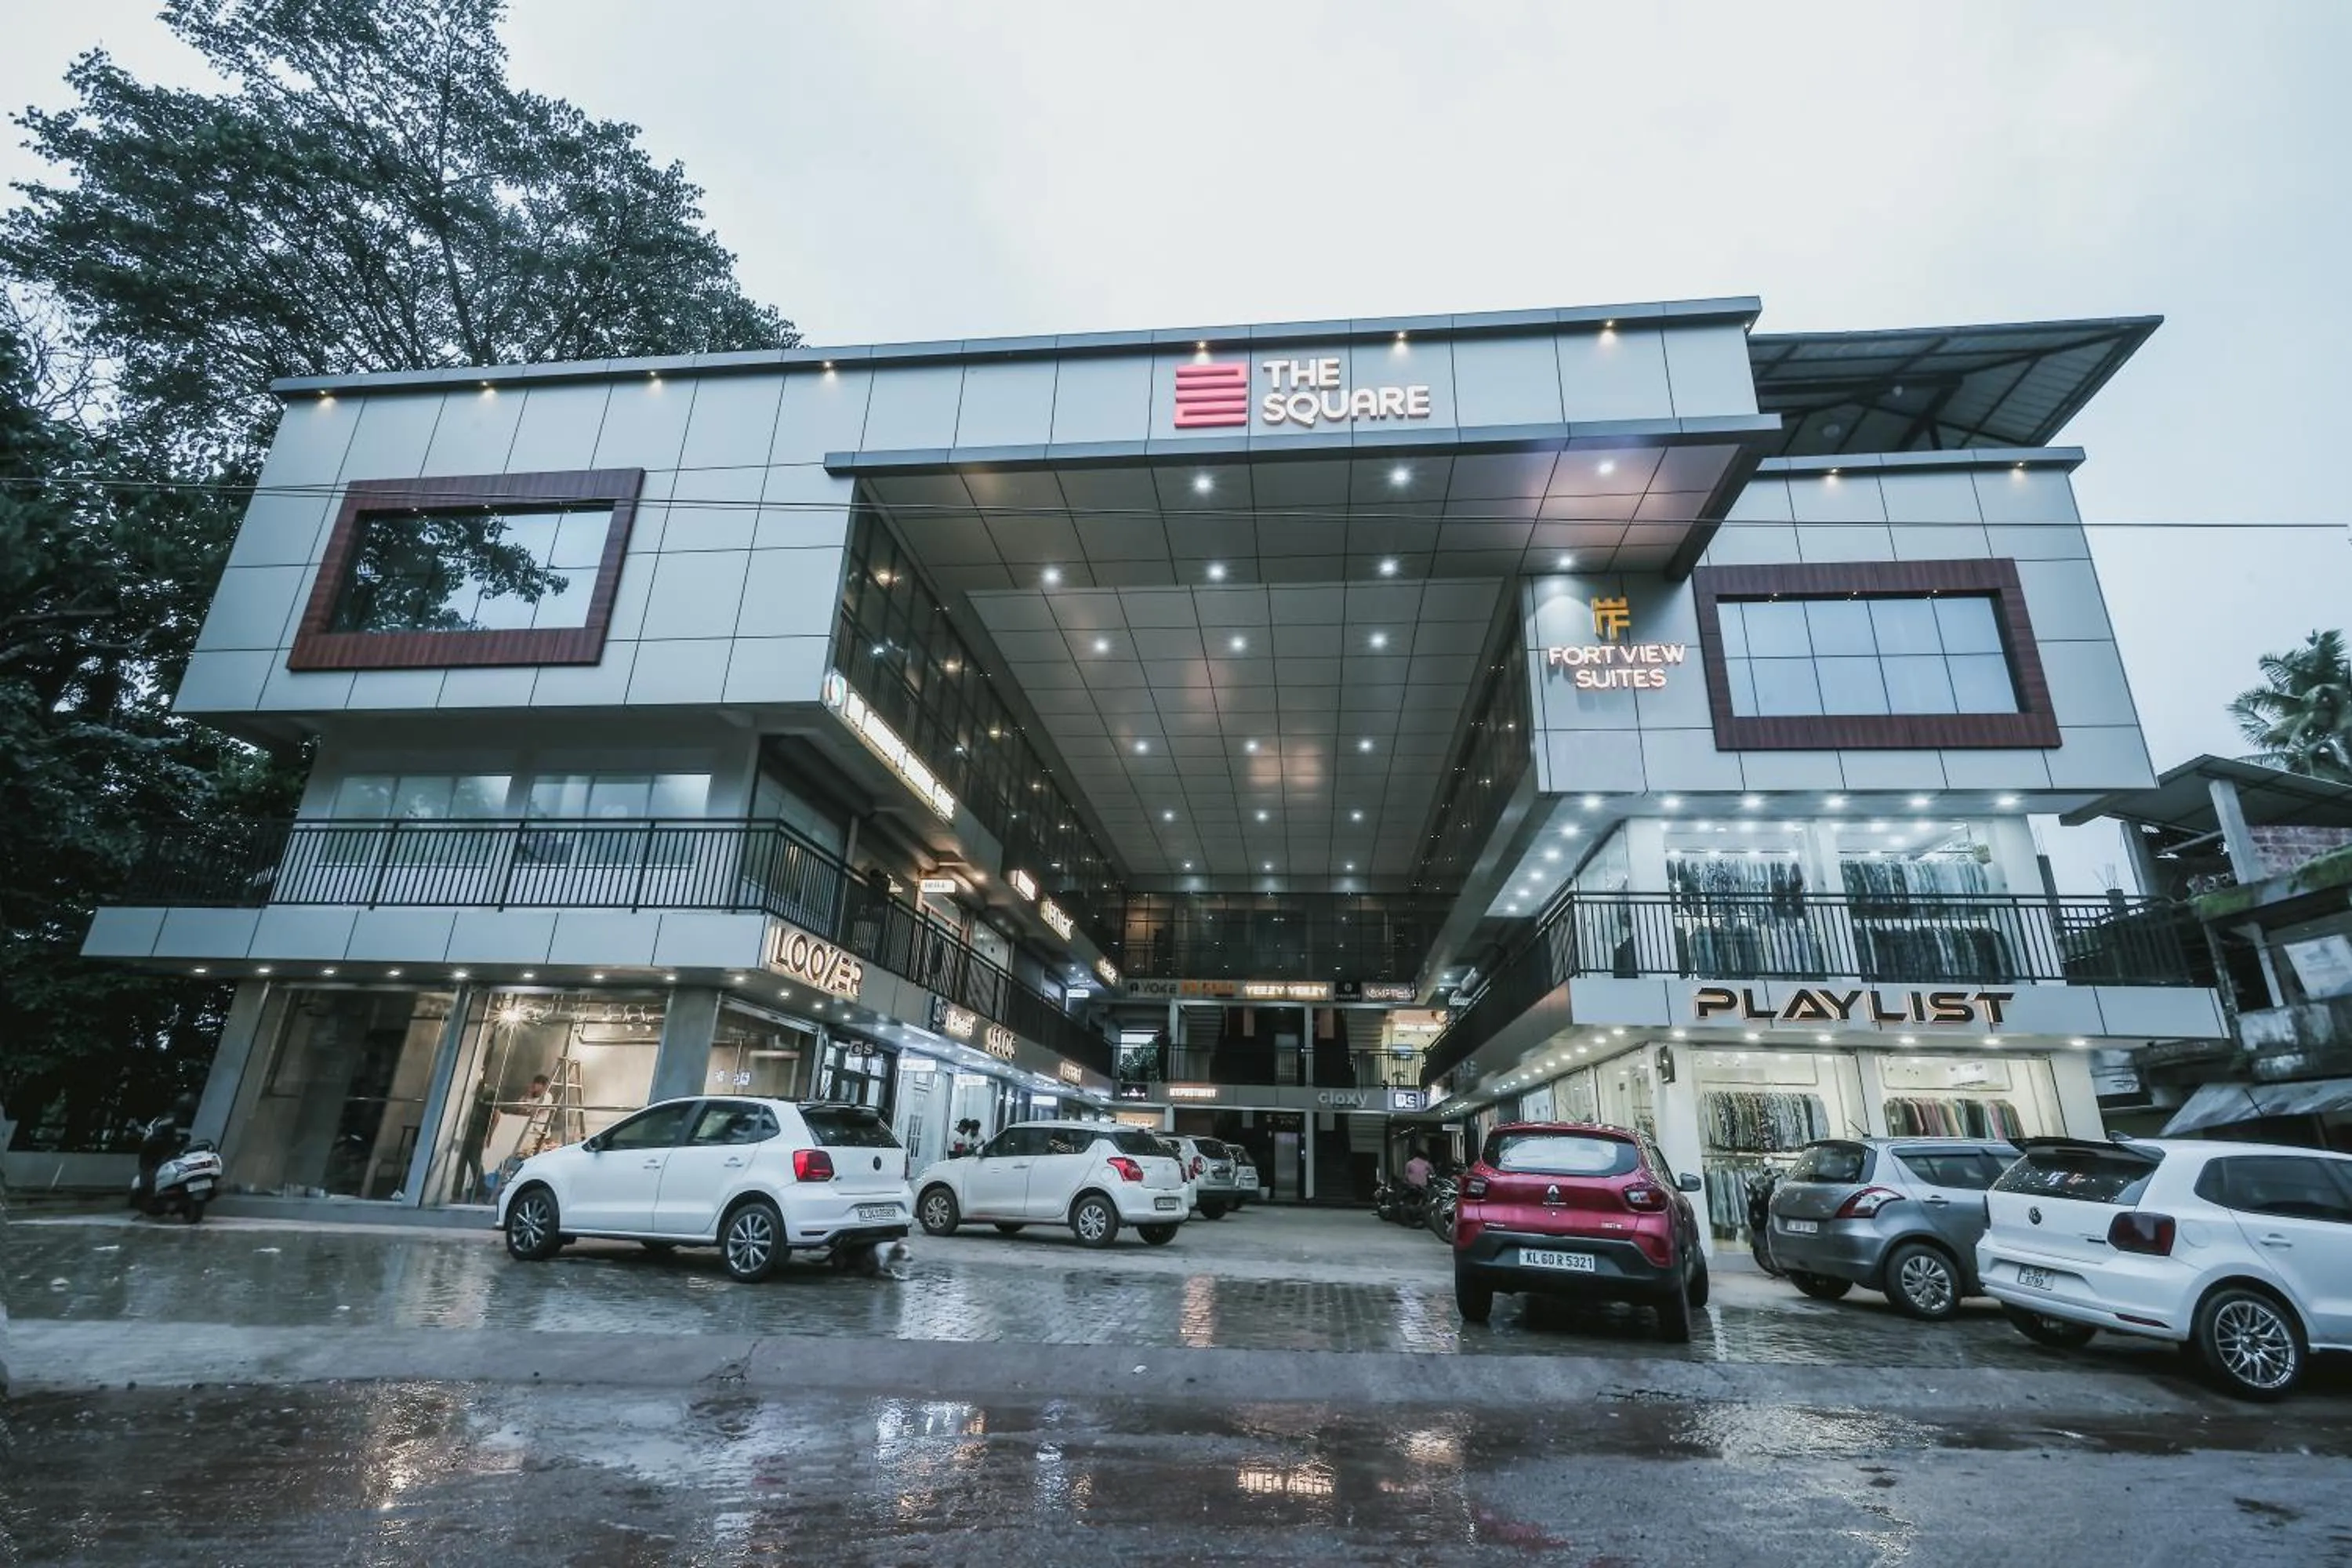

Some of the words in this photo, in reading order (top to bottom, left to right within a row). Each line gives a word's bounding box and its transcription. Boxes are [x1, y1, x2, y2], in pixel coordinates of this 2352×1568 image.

[1263, 358, 1341, 390] THE
[1262, 385, 1431, 428] SQUARE
[1548, 645, 1616, 666] FORT
[1619, 644, 1686, 664] VIEW
[1575, 668, 1668, 688] SUITES
[1694, 985, 2015, 1024] PLAYLIST
[1526, 1252, 1539, 1264] KL
[1556, 1254, 1564, 1266] R
[1566, 1255, 1593, 1269] 5321
